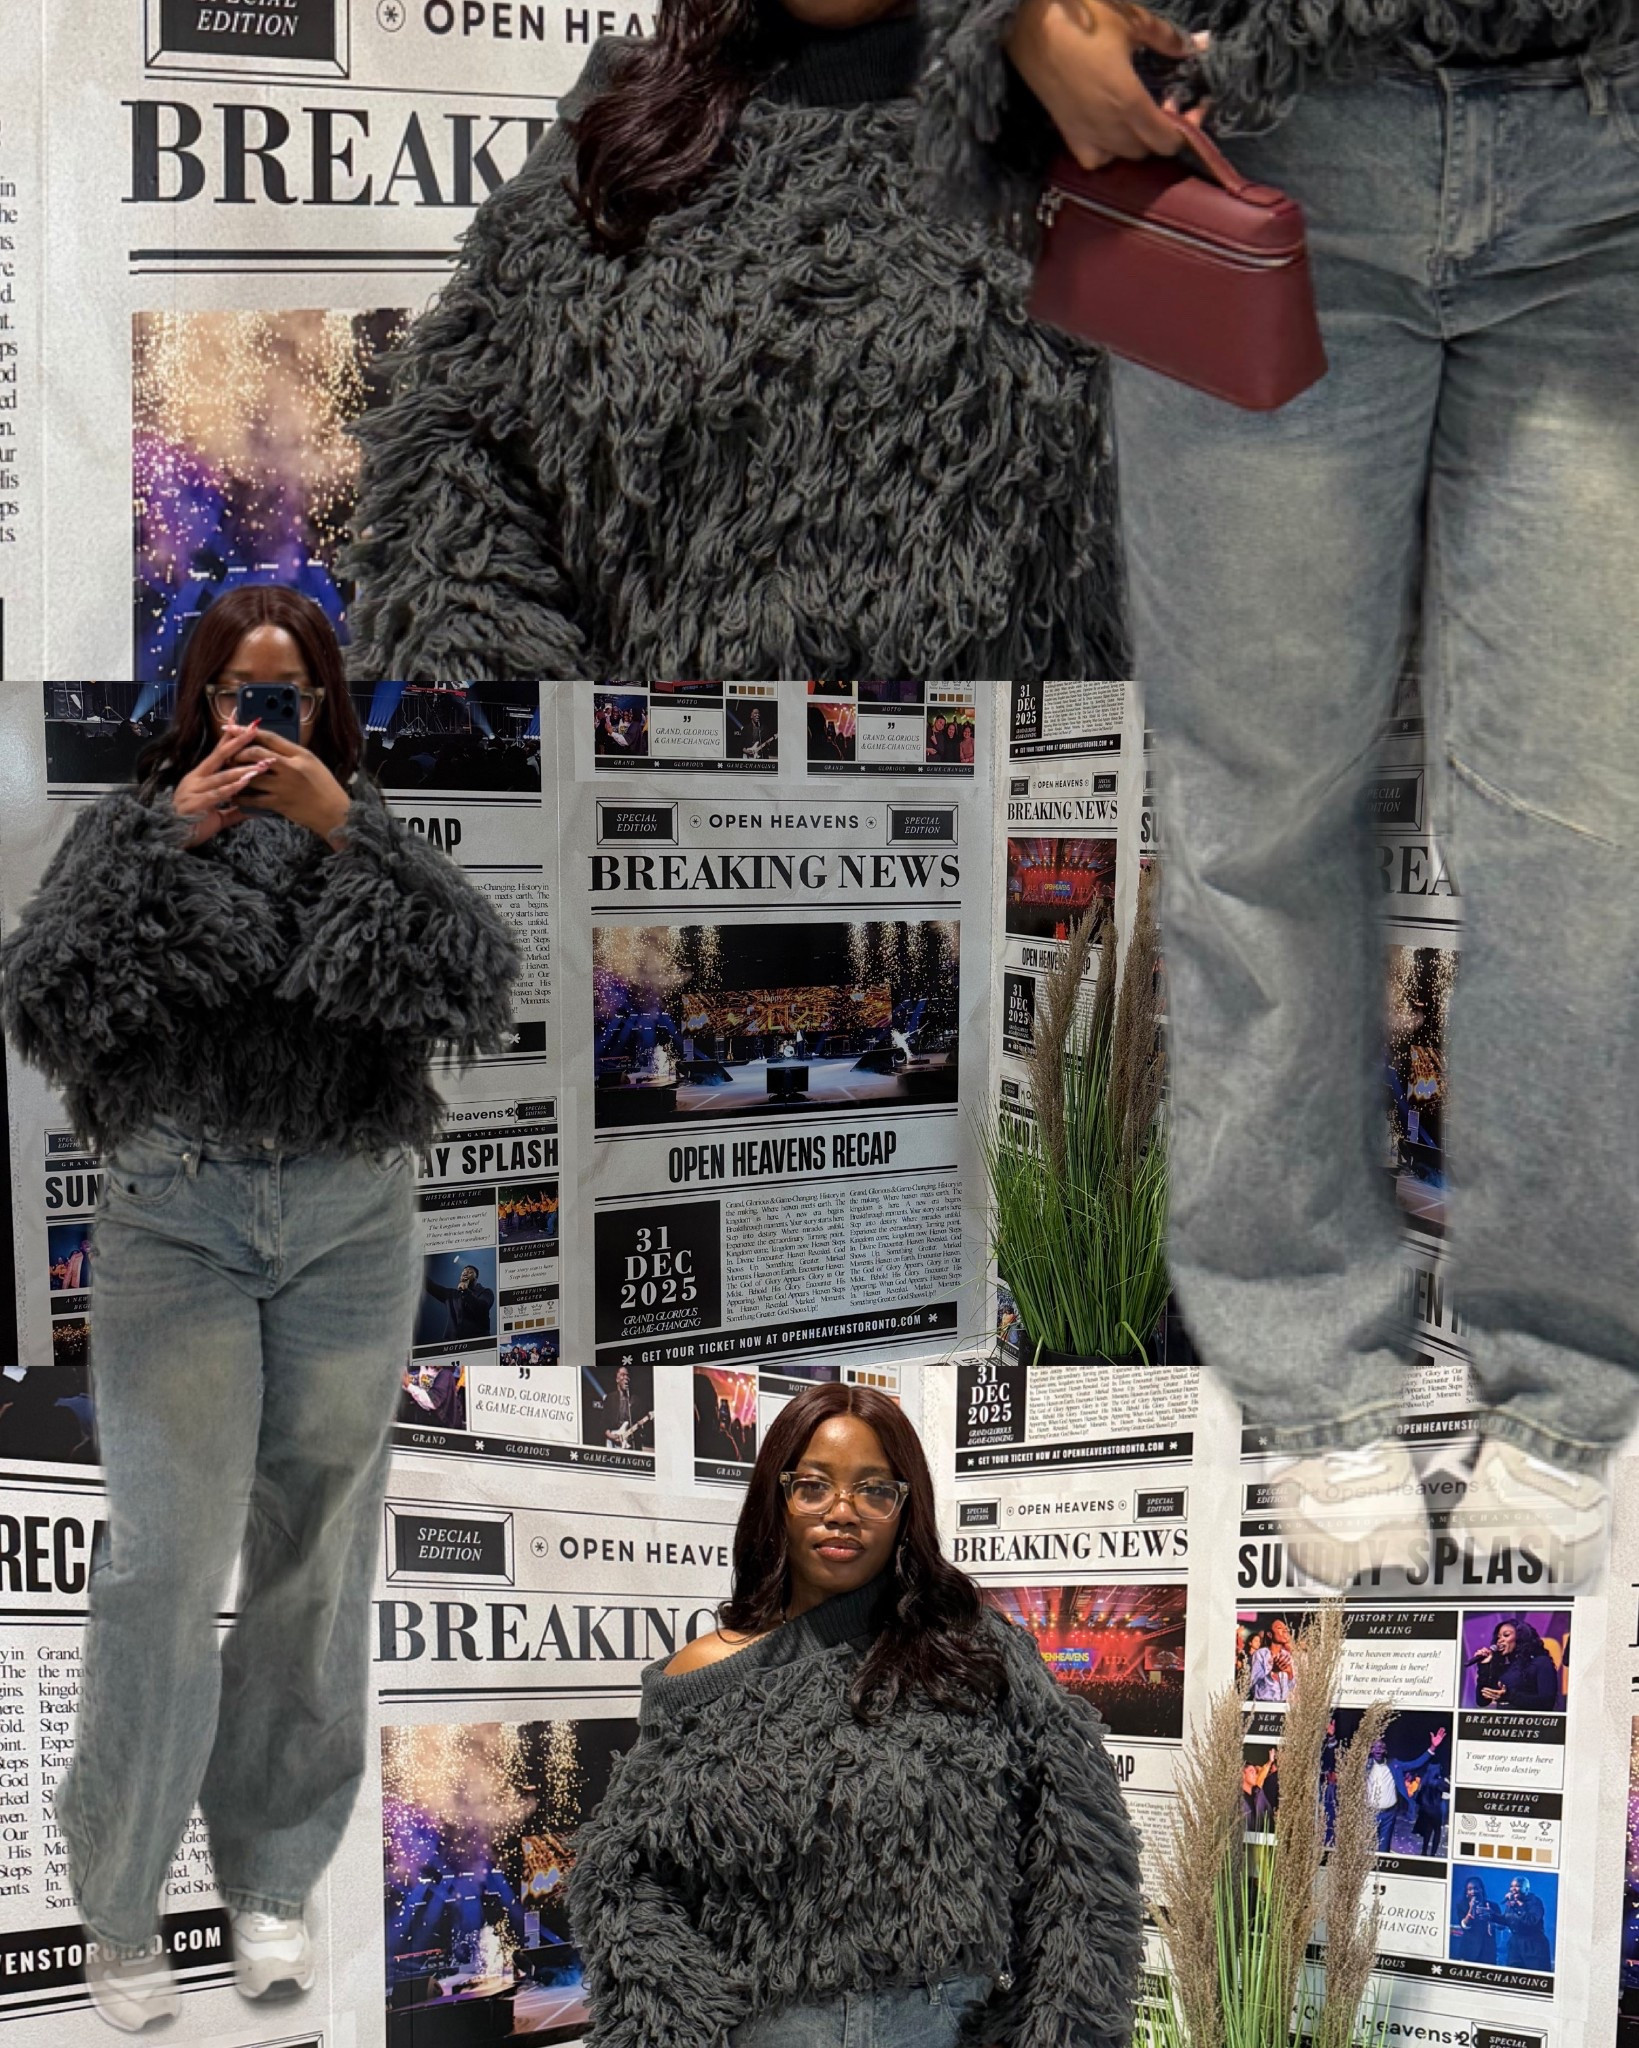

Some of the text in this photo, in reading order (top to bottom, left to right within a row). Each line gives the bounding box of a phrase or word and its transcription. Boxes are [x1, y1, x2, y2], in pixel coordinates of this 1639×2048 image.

[197, 9, 299, 37] EDITION
[424, 0, 657, 44] OPEN HEA
[1021, 684, 1030, 698] 31
[1017, 697, 1036, 712] DEC
[1016, 711, 1036, 725] 2025
[655, 728, 682, 736] GRAND,
[887, 734, 920, 742] GLORIOUS
[1055, 780, 1083, 788] HEAVENS
[1007, 800, 1118, 820] BREAKING NEWS
[617, 813, 657, 822] SPECIAL
[709, 814, 859, 828] OPEN HEAVENS
[905, 817, 940, 825] SPECIAL
[617, 824, 657, 832] EDITION
[905, 826, 940, 834] EDITION
[587, 855, 960, 891] BREAKING NEWS
[538, 891, 549, 899] The
[1022, 948, 1037, 967] OPEN
[1013, 984, 1022, 997] 31
[1010, 996, 1027, 1011] DEC
[1009, 1010, 1028, 1025] 2025
[462, 1138, 558, 1175] SPLASH
[669, 1131, 896, 1183] OPEN HEAVENS RECAP
[636, 1226, 671, 1252] 31
[625, 1250, 692, 1281] DEC
[621, 1276, 697, 1309] 2025
[656, 1308, 699, 1320] GLORIOUS
[642, 1315, 921, 1362] GET YOUR TICKET NOW AT OPENHEAVENSTORONTO.COM
[977, 1366, 998, 1385] 31
[478, 1384, 571, 1406] GRAND, GLORIOUS
[971, 1383, 1010, 1405] DEC
[967, 1403, 1012, 1425] 2025
[412, 1434, 652, 1468] GRAND GLORIOUS GAME-CHANGING
[978, 1442, 1164, 1465] GET YOUR TICKET NOW AT OPENHEAVENSTORONTO.COM
[716, 1467, 742, 1478] GRAND
[1018, 1500, 1115, 1516] OPEN HEAVENS
[1147, 1505, 1174, 1513] EDITION
[418, 1528, 481, 1544] SPECIAL
[418, 1545, 482, 1561] EDITION
[560, 1536, 634, 1562] OPEN
[952, 1529, 1189, 1563] BREAKING NEWS
[1347, 1613, 1435, 1623] HISTORY IN THE
[1368, 1626, 1412, 1635] MAKING
[37, 1646, 83, 1662] Grand,
[38, 1665, 60, 1678] the
[1349, 1662, 1364, 1671] The
[1366, 1662, 1398, 1673] kingdom
[1400, 1663, 1406, 1671] is
[1345, 1675, 1369, 1684] Where
[40, 1718, 69, 1735] Step
[1465, 1715, 1559, 1727] BREAKTHROUGH
[1482, 1729, 1541, 1739] MOMENTS
[1466, 1752, 1554, 1764] Your story starts here
[1473, 1763, 1541, 1776] Step into destiny
[0, 1772, 58, 1788] God In.
[1477, 1791, 1540, 1802] SOMETHING
[1484, 1803, 1531, 1814] GREATER
[3, 1827, 29, 1841] Our
[8, 1845, 32, 1859] His
[45, 1879, 62, 1891] In.
[165, 1882, 191, 1896] God
[1449, 1967, 1549, 1988] GAME-CHANGING
